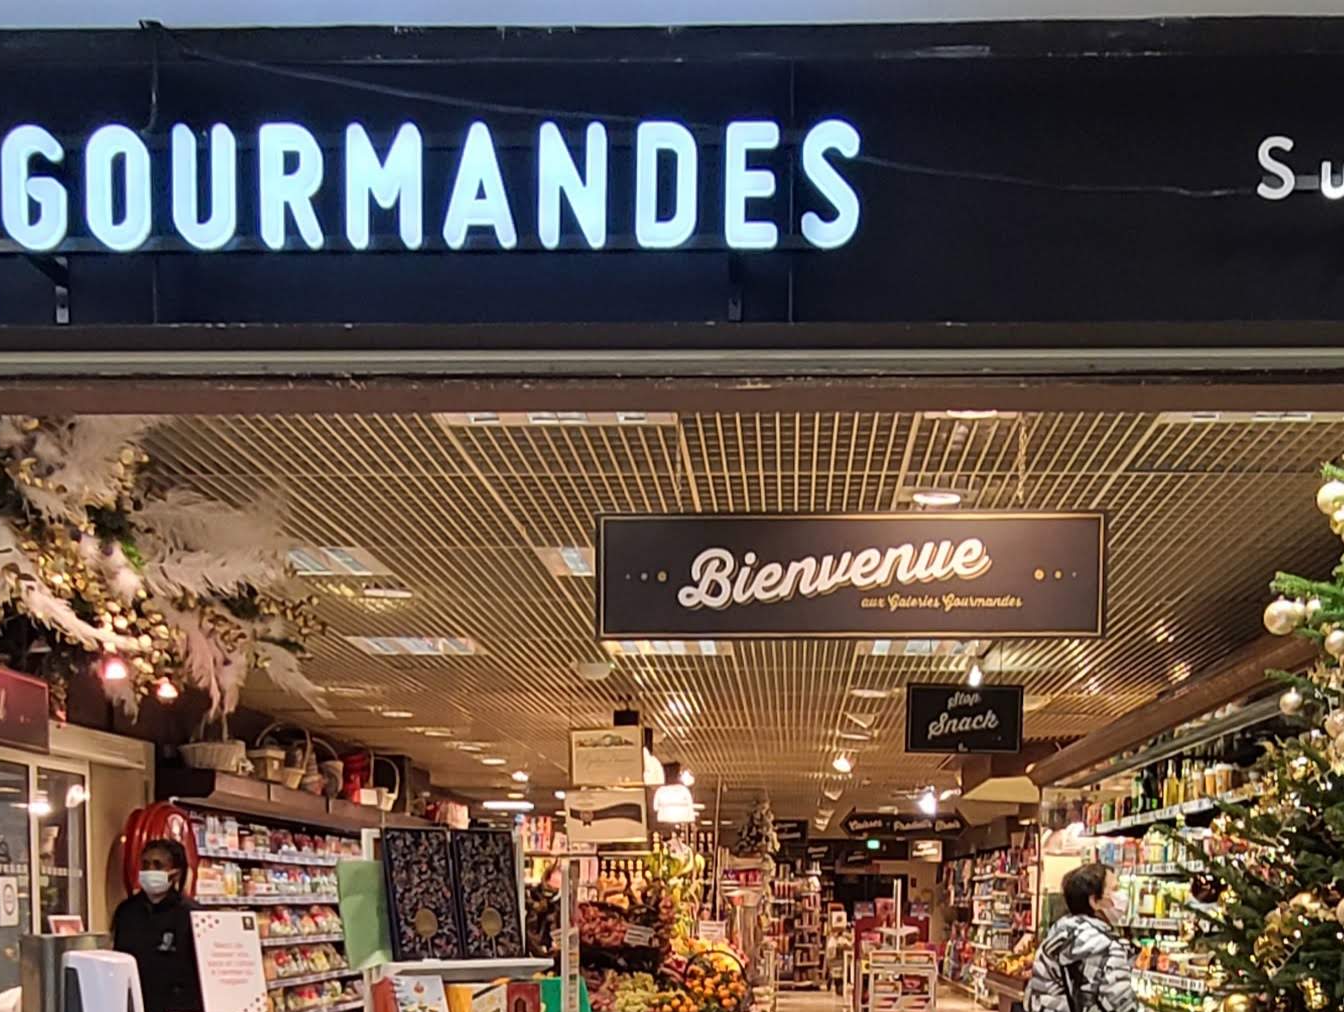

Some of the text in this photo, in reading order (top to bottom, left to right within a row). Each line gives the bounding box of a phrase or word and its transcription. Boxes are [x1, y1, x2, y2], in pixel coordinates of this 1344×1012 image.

[0, 119, 861, 252] GOURMANDES
[677, 537, 992, 611] Bienvenue
[860, 591, 1023, 613] aux Galeries Gourmandes
[927, 709, 1000, 740] Snack
